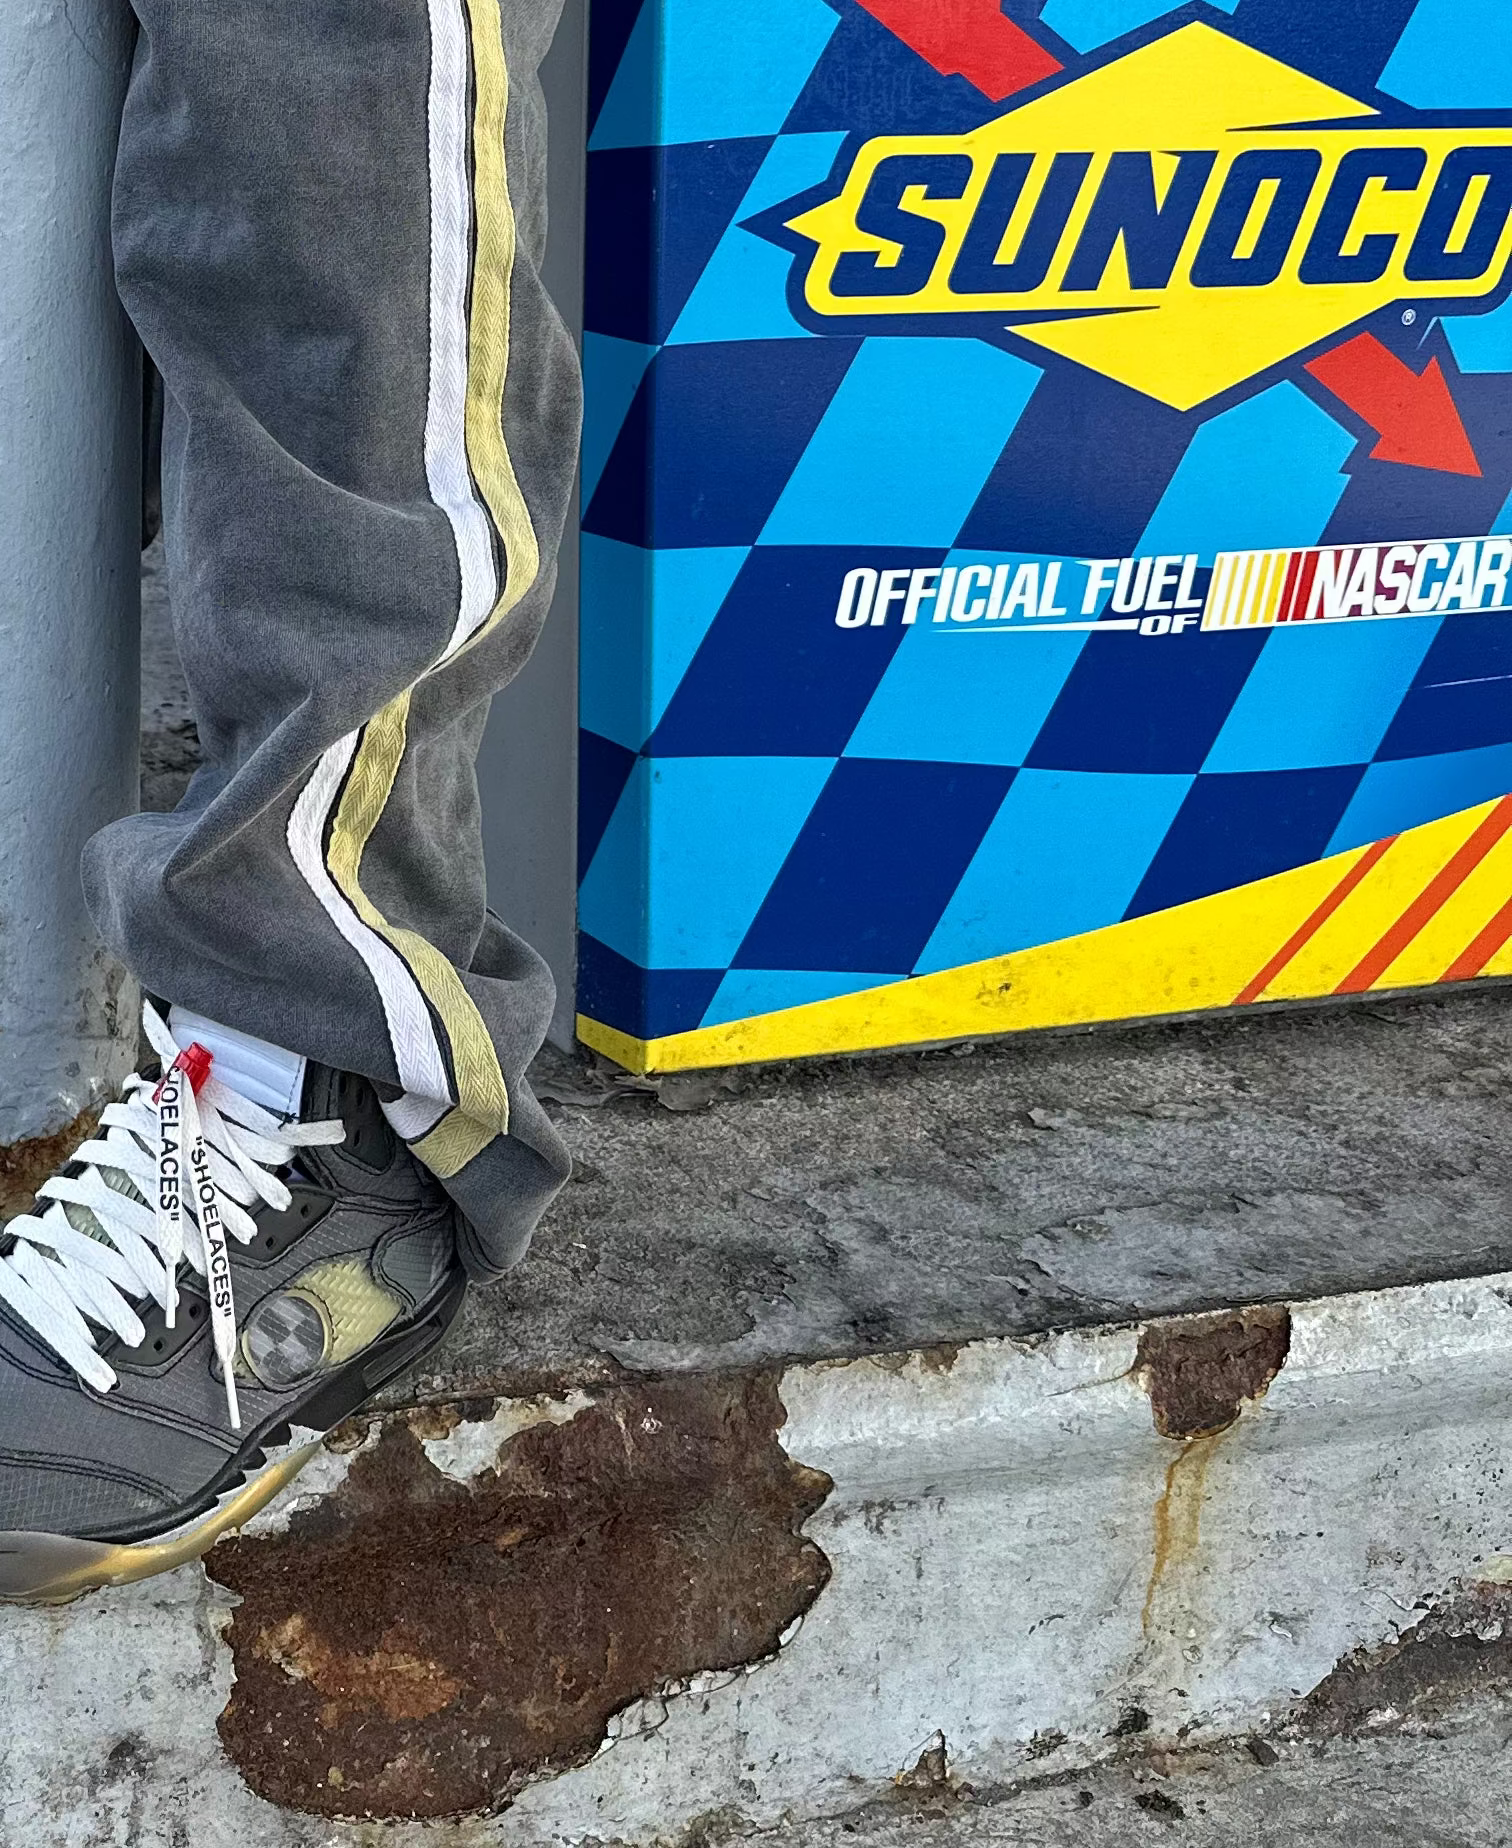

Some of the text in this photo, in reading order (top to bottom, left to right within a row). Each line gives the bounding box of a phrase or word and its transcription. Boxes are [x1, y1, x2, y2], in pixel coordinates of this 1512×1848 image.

[828, 145, 1512, 298] SUNOCO
[835, 538, 1512, 637] OFFICIAL FUEL OF NASCAR
[191, 1135, 232, 1318] "SHOELACES"
